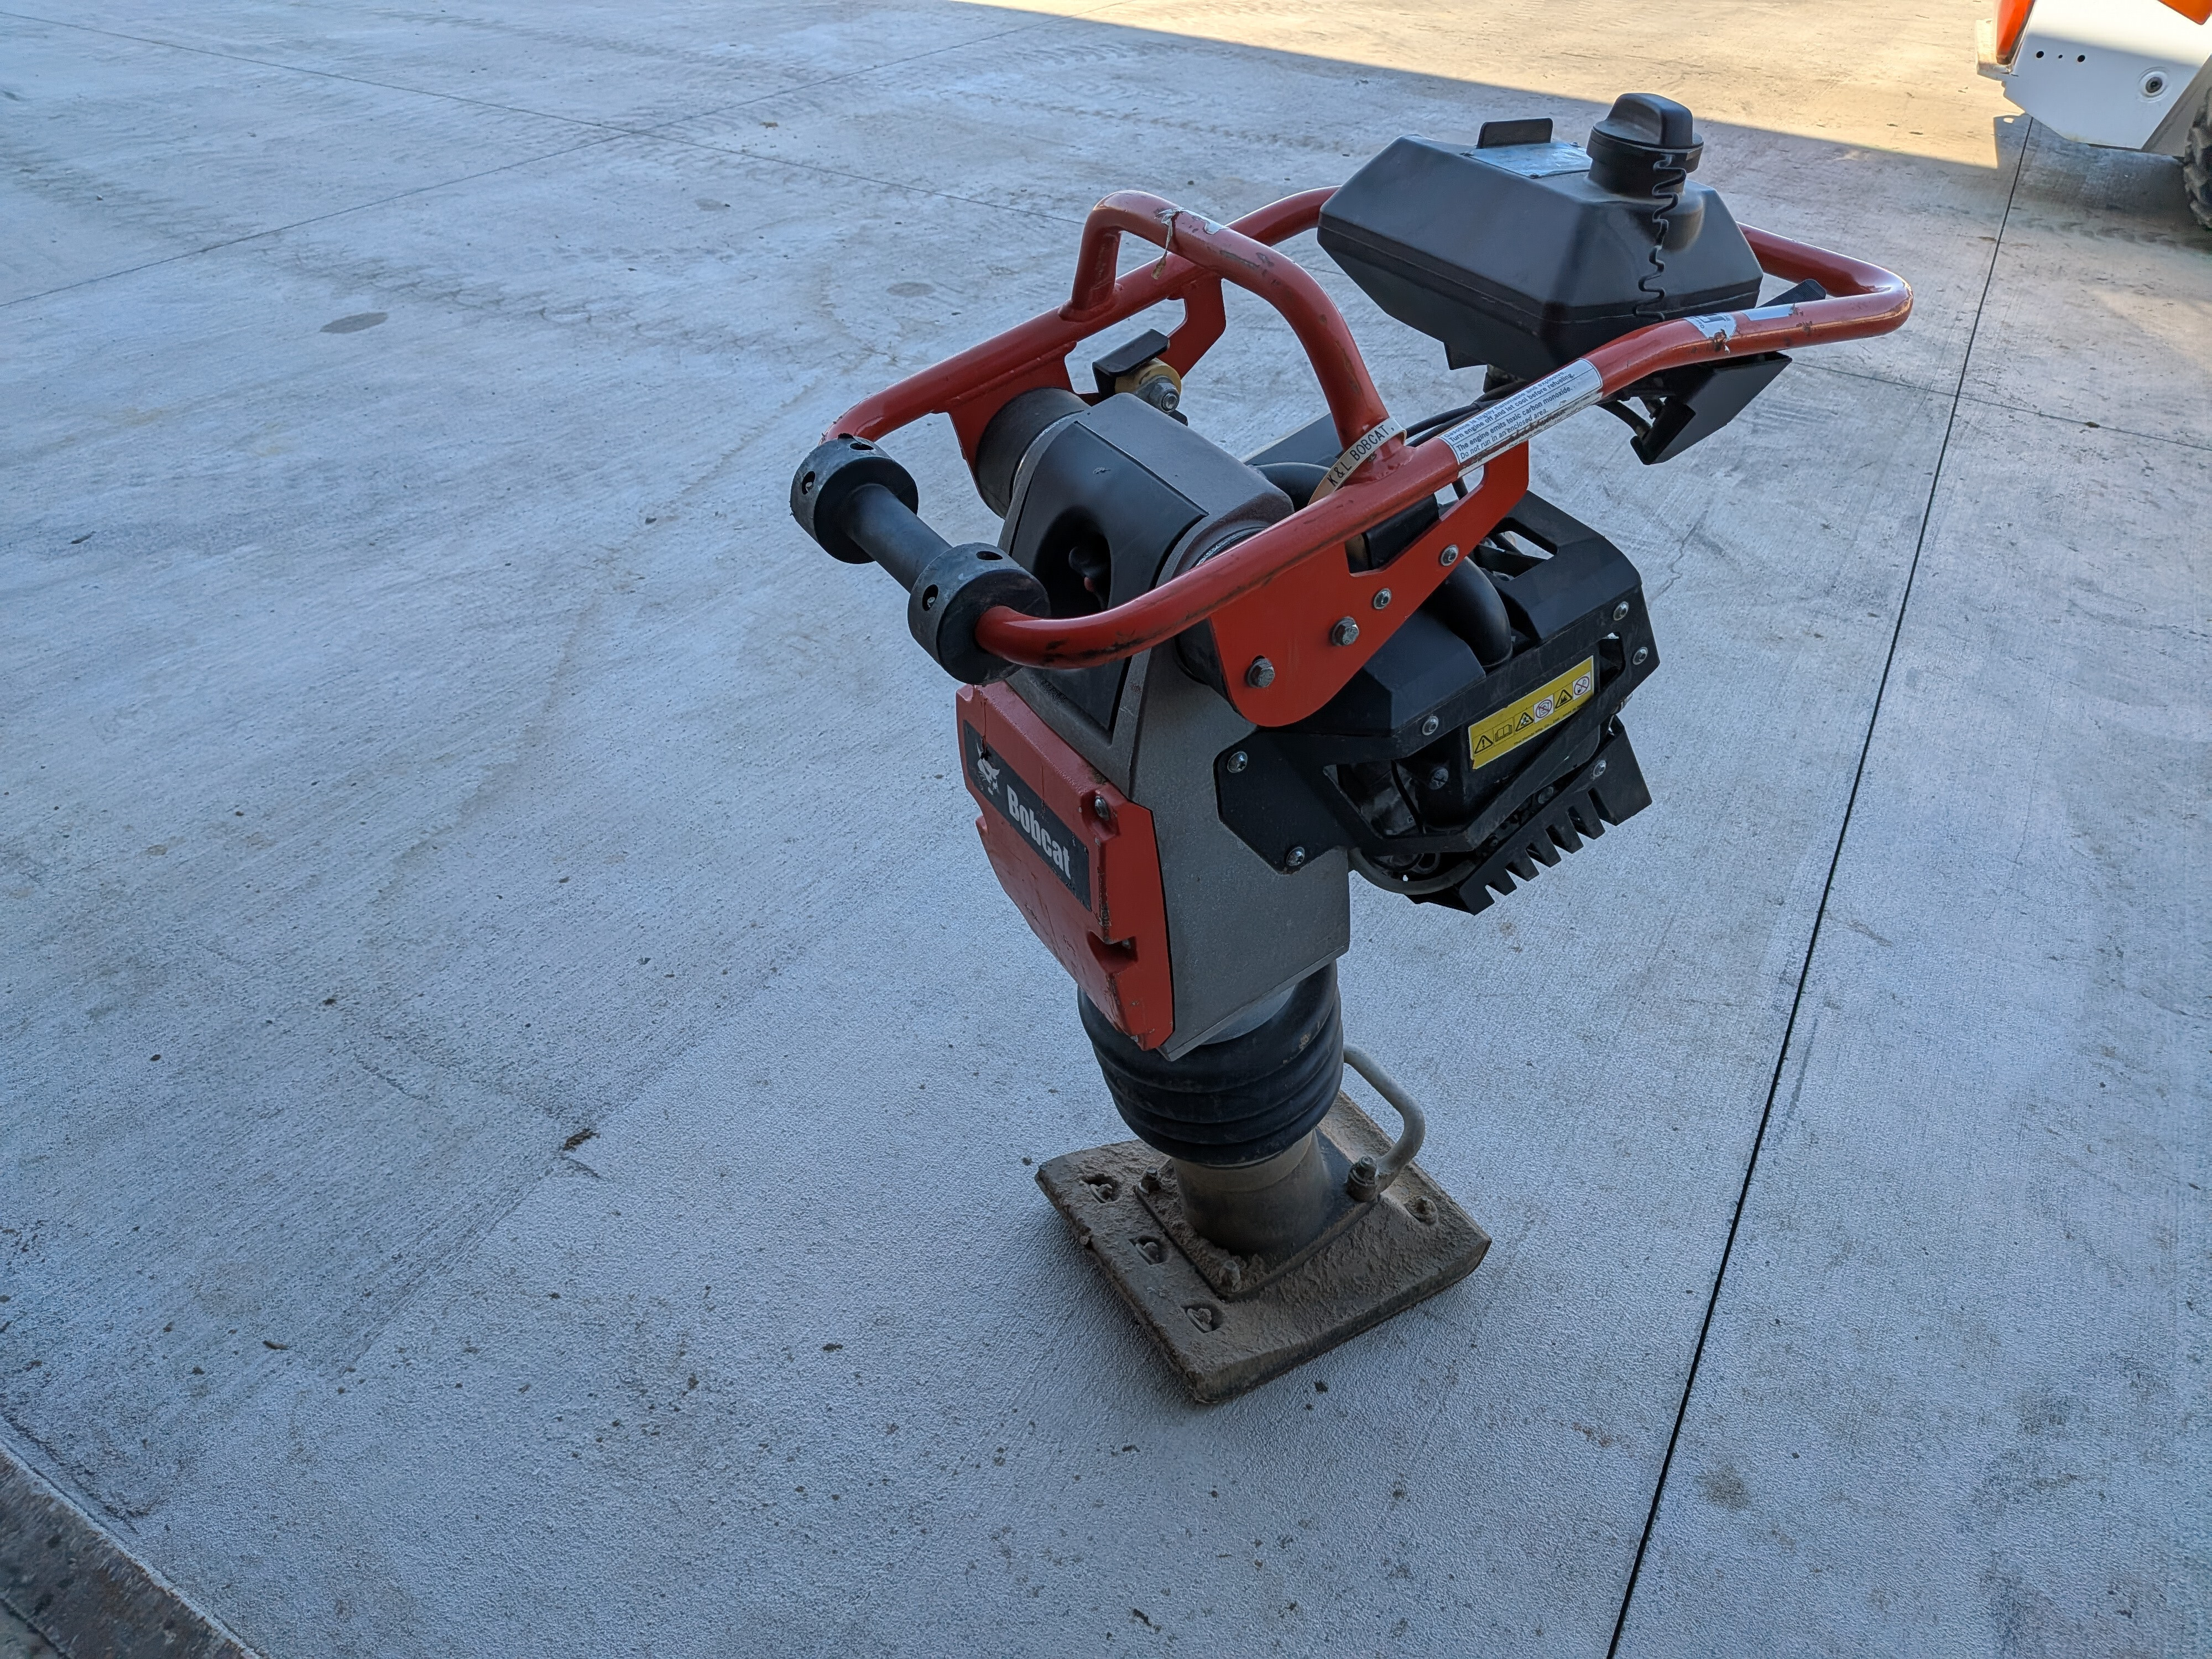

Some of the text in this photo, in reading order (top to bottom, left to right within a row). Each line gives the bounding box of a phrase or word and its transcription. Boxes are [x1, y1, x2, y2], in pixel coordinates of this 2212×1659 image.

[1449, 434, 1464, 442] Turn
[1464, 422, 1484, 435] engine
[1515, 397, 1528, 406] cool
[1527, 388, 1547, 399] before
[1547, 373, 1575, 389] refueling.
[1455, 442, 1469, 452] The
[1469, 431, 1489, 445] engine
[1490, 421, 1506, 434] emits
[1506, 413, 1521, 424] toxic
[1522, 401, 1543, 415] carbon
[1543, 387, 1573, 404] monoxide.
[1470, 445, 1480, 455] not
[1480, 439, 1491, 448] run
[1507, 416, 1533, 433] enclosed
[1533, 408, 1548, 419] area.
[1475, 409, 1495, 420] highly
[1327, 476, 1338, 487] K
[1333, 467, 1345, 478] &
[1340, 461, 1352, 471] L
[1006, 784, 1071, 880] Bobcat
